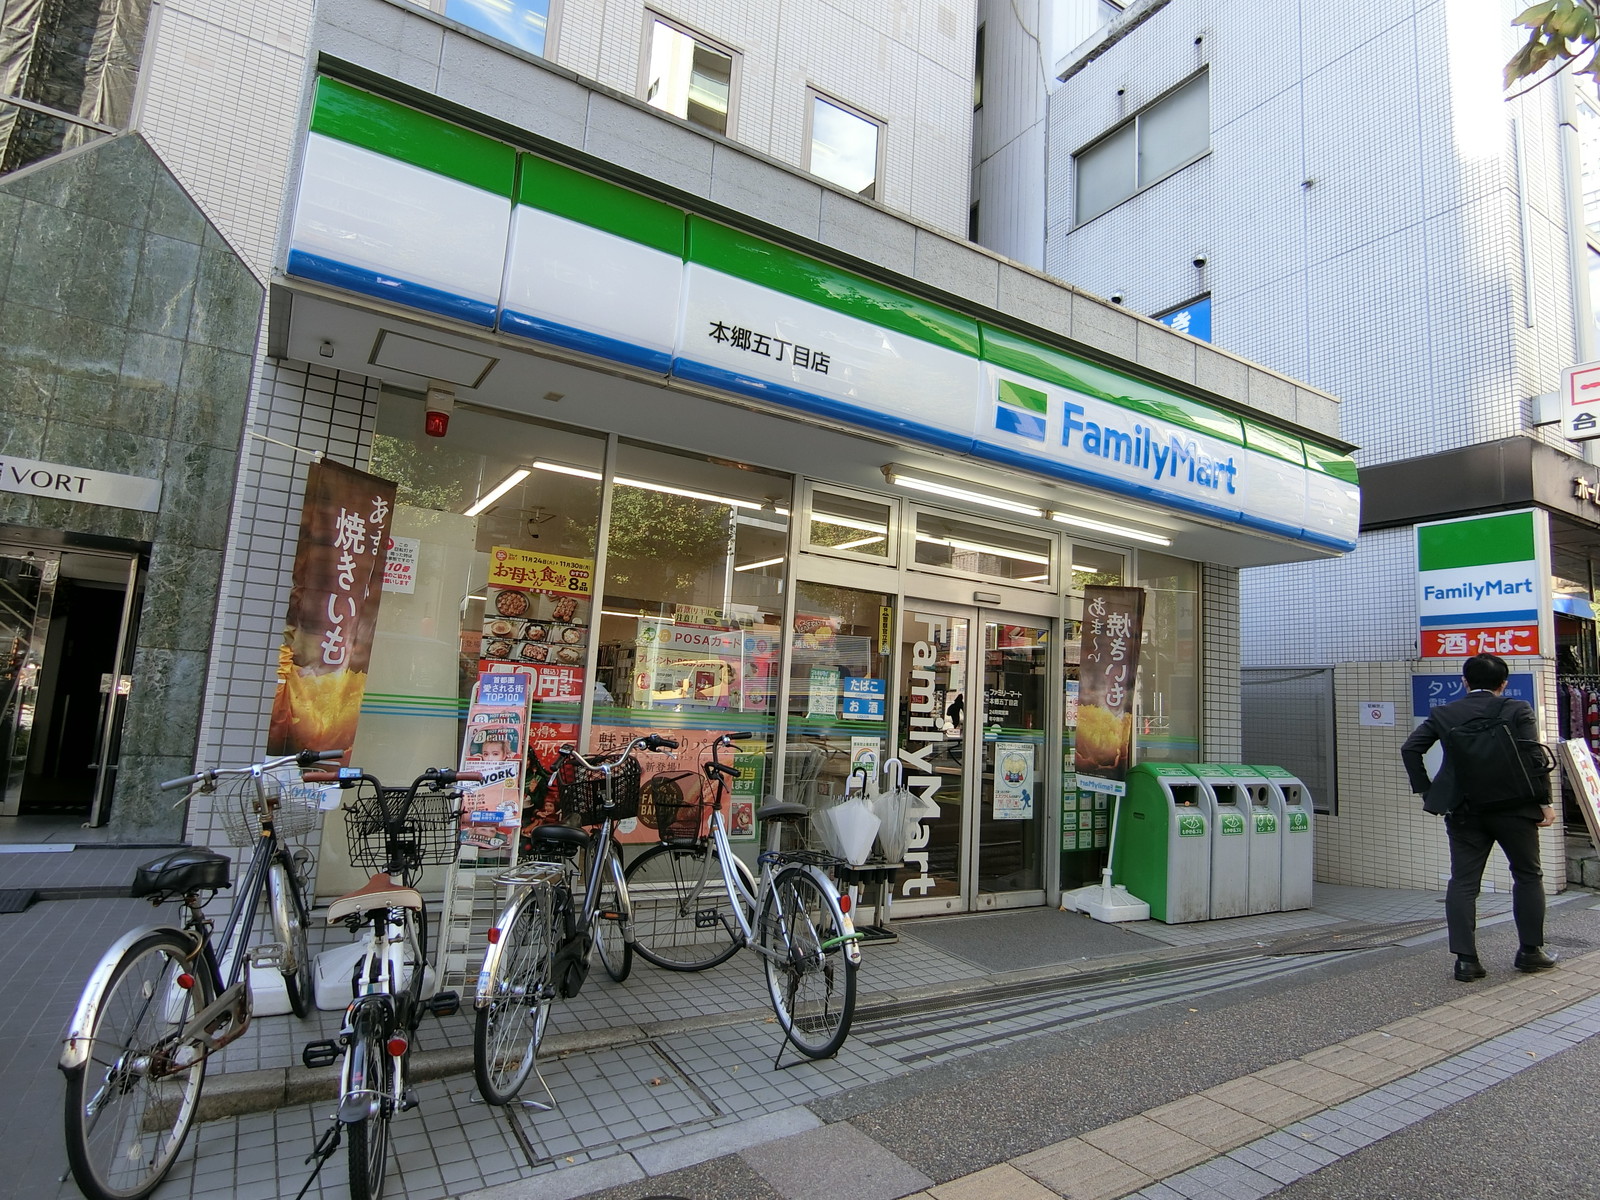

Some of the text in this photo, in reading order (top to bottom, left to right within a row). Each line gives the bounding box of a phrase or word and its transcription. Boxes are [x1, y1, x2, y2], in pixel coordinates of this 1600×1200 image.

[709, 321, 831, 375] 本郷五丁目店
[1062, 400, 1237, 495] FamilyMart
[11, 466, 92, 494] VORT
[384, 572, 411, 580] 報のご協力を
[493, 562, 566, 587] お母さん食堂
[322, 508, 366, 665] 焼きいも
[1424, 578, 1532, 601] FamilyMart
[675, 632, 742, 648] POSAカード
[1437, 630, 1532, 655] 酒・たばこ
[483, 684, 524, 693] 愛される街
[850, 679, 879, 692] たばこ
[486, 693, 519, 702] TOP100
[529, 725, 557, 738] お得な
[898, 613, 948, 897] FamilyMart
[646, 761, 681, 773] 新登場!
